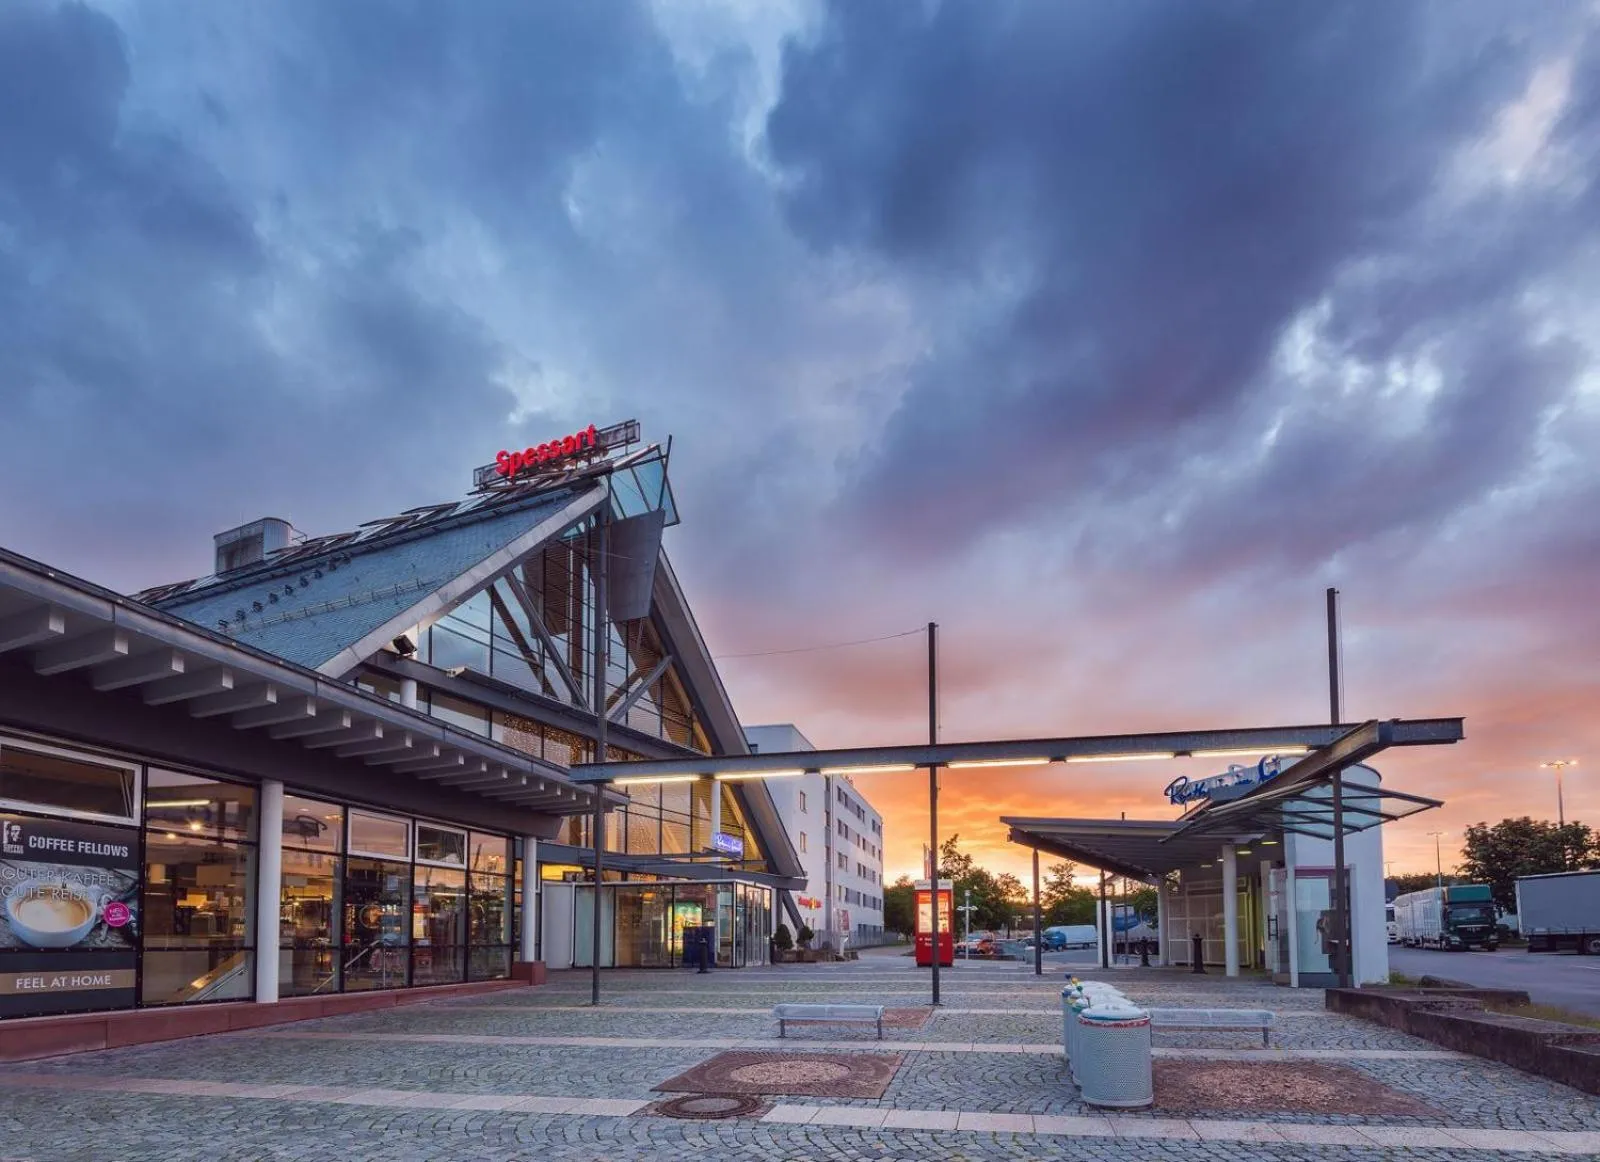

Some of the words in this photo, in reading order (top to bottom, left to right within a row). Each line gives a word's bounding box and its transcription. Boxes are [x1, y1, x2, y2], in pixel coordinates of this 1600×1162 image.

[495, 423, 598, 477] Spessart
[28, 835, 75, 852] COFFEE
[78, 841, 129, 857] FELLOWS
[16, 977, 47, 989] FEEL
[50, 976, 67, 988] AT
[71, 975, 112, 987] HOME
